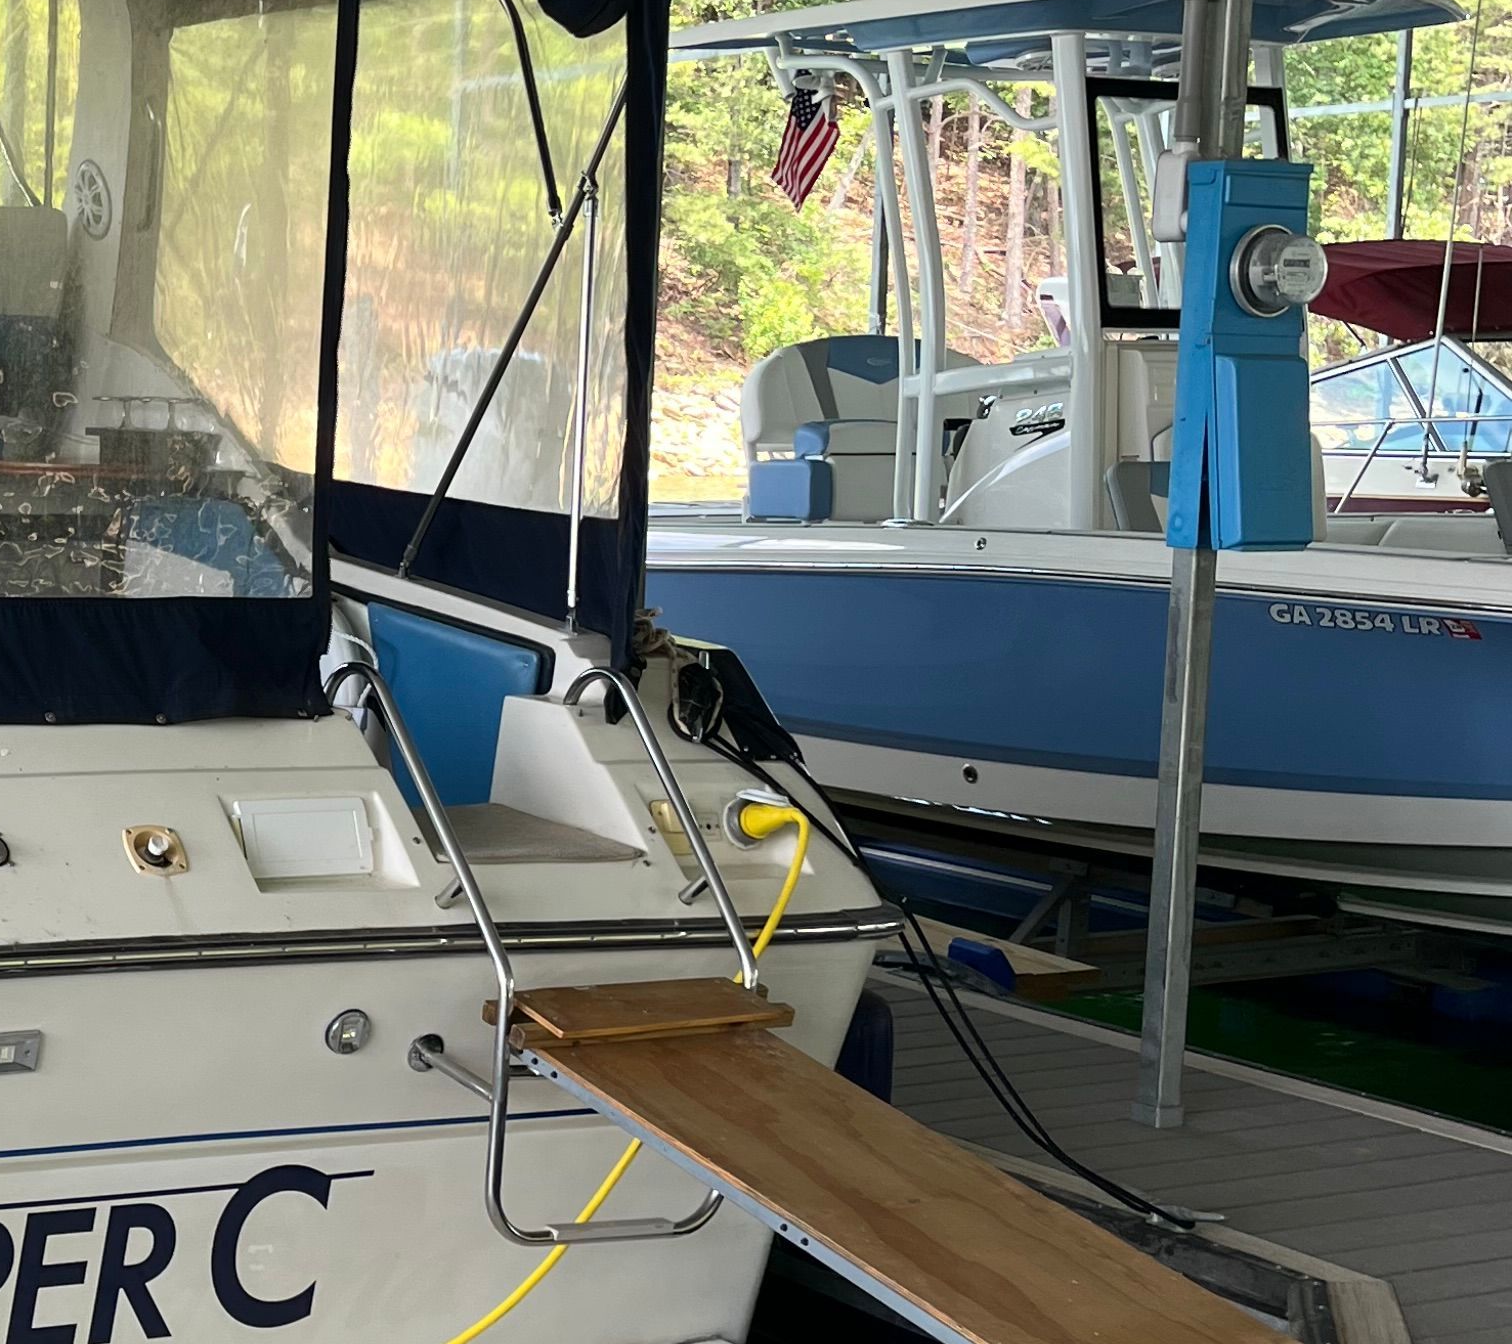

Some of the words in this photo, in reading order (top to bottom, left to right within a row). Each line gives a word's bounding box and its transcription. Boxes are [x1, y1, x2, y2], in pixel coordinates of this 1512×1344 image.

[1268, 603, 1312, 626] GA
[1315, 607, 1395, 632] 2854
[1401, 615, 1441, 635] LR
[211, 1164, 333, 1328] C
